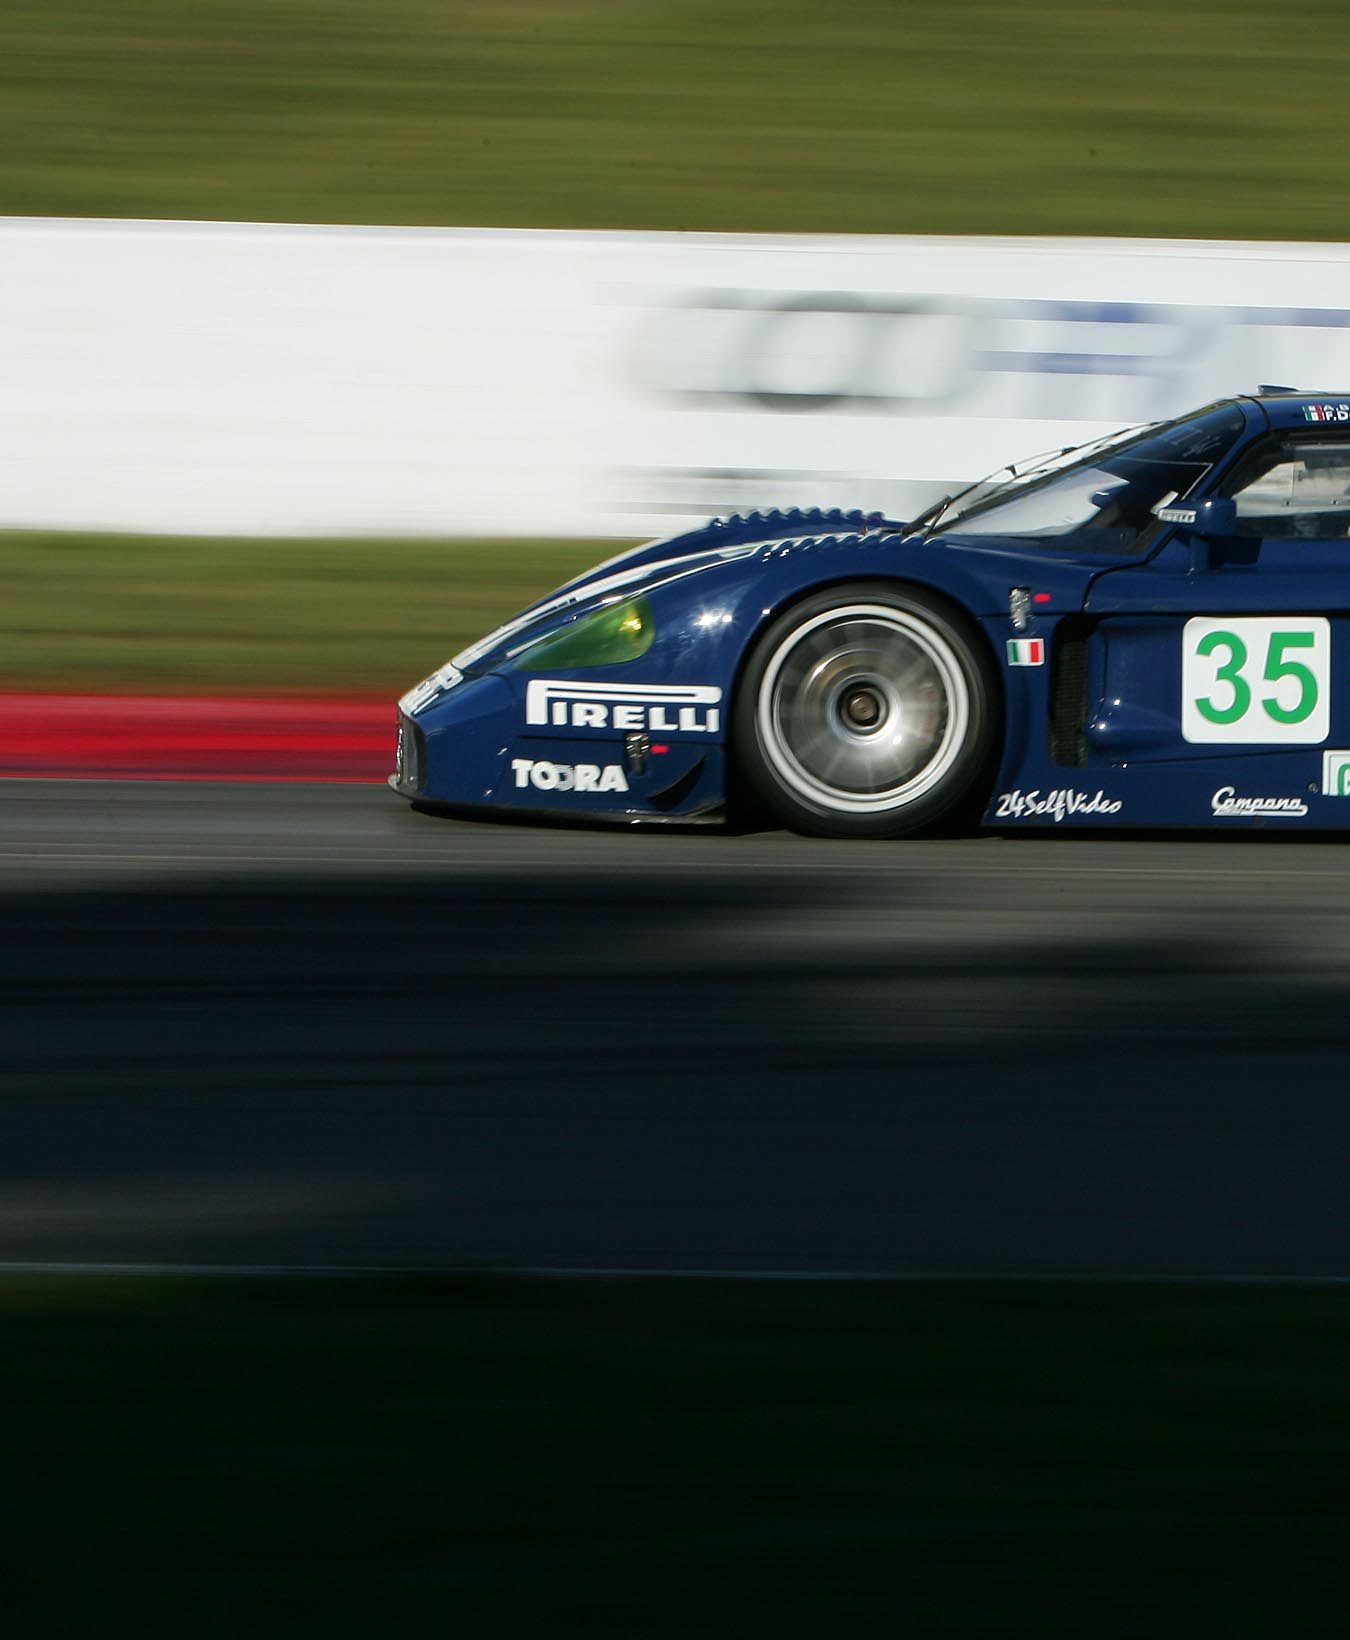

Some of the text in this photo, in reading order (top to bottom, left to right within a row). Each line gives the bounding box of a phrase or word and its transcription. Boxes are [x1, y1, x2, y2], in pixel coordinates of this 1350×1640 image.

[1195, 630, 1319, 725] 35
[526, 679, 723, 733] PIRELLI
[1211, 786, 1308, 816] Campana
